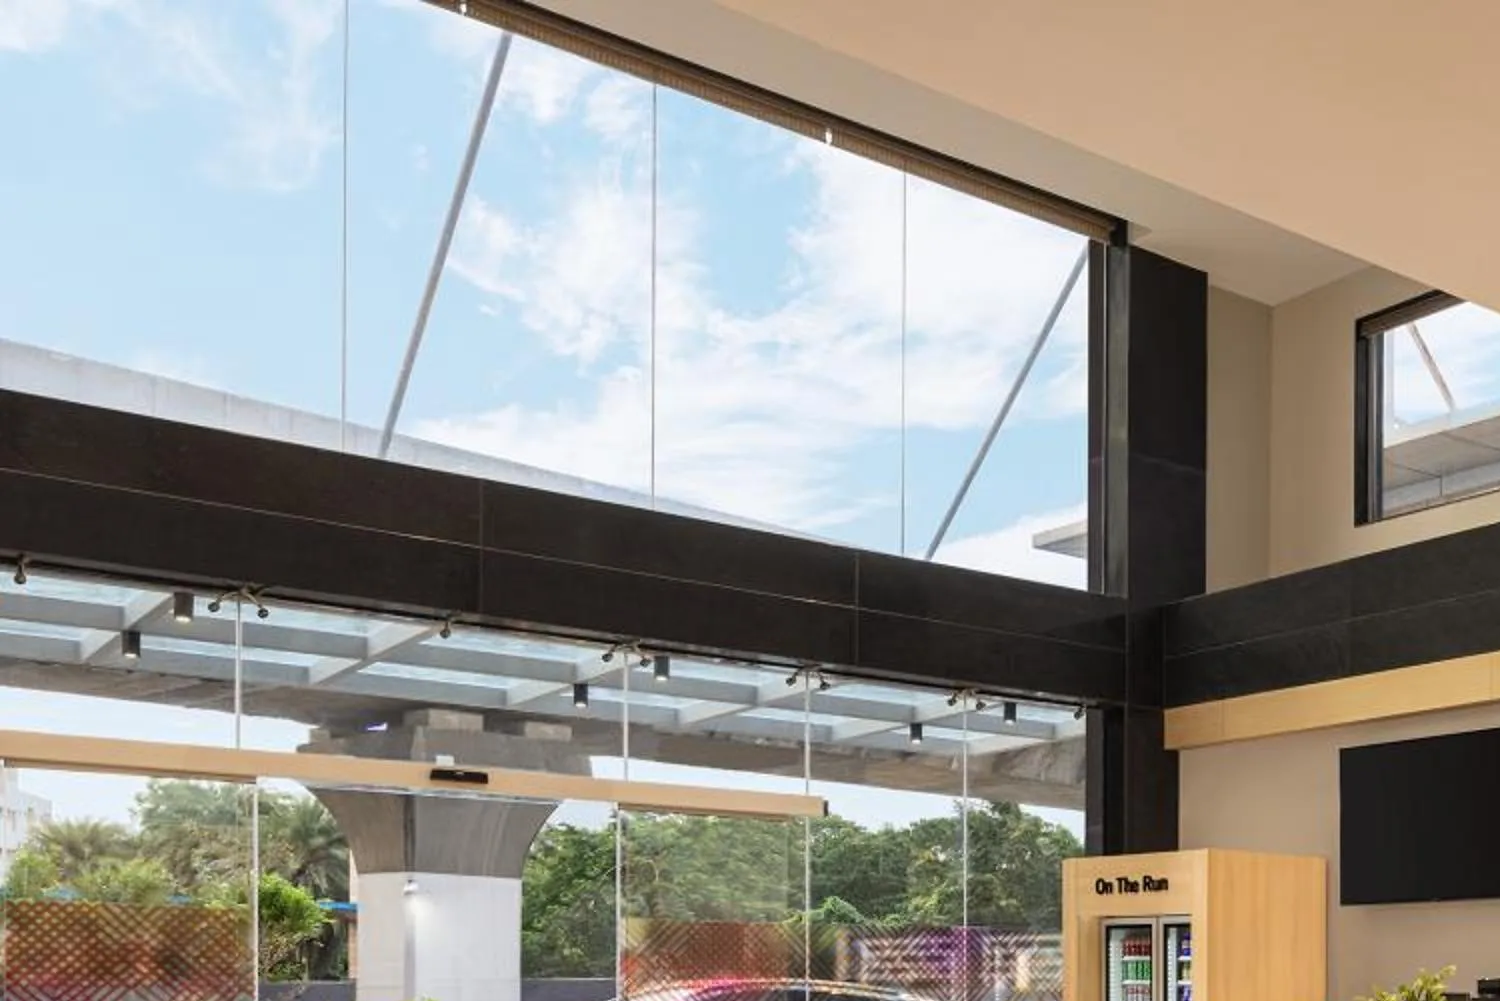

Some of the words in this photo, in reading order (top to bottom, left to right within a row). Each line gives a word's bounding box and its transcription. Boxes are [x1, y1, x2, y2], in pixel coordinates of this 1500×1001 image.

[1095, 878, 1113, 895] On
[1116, 876, 1139, 894] The
[1143, 875, 1169, 892] Run
